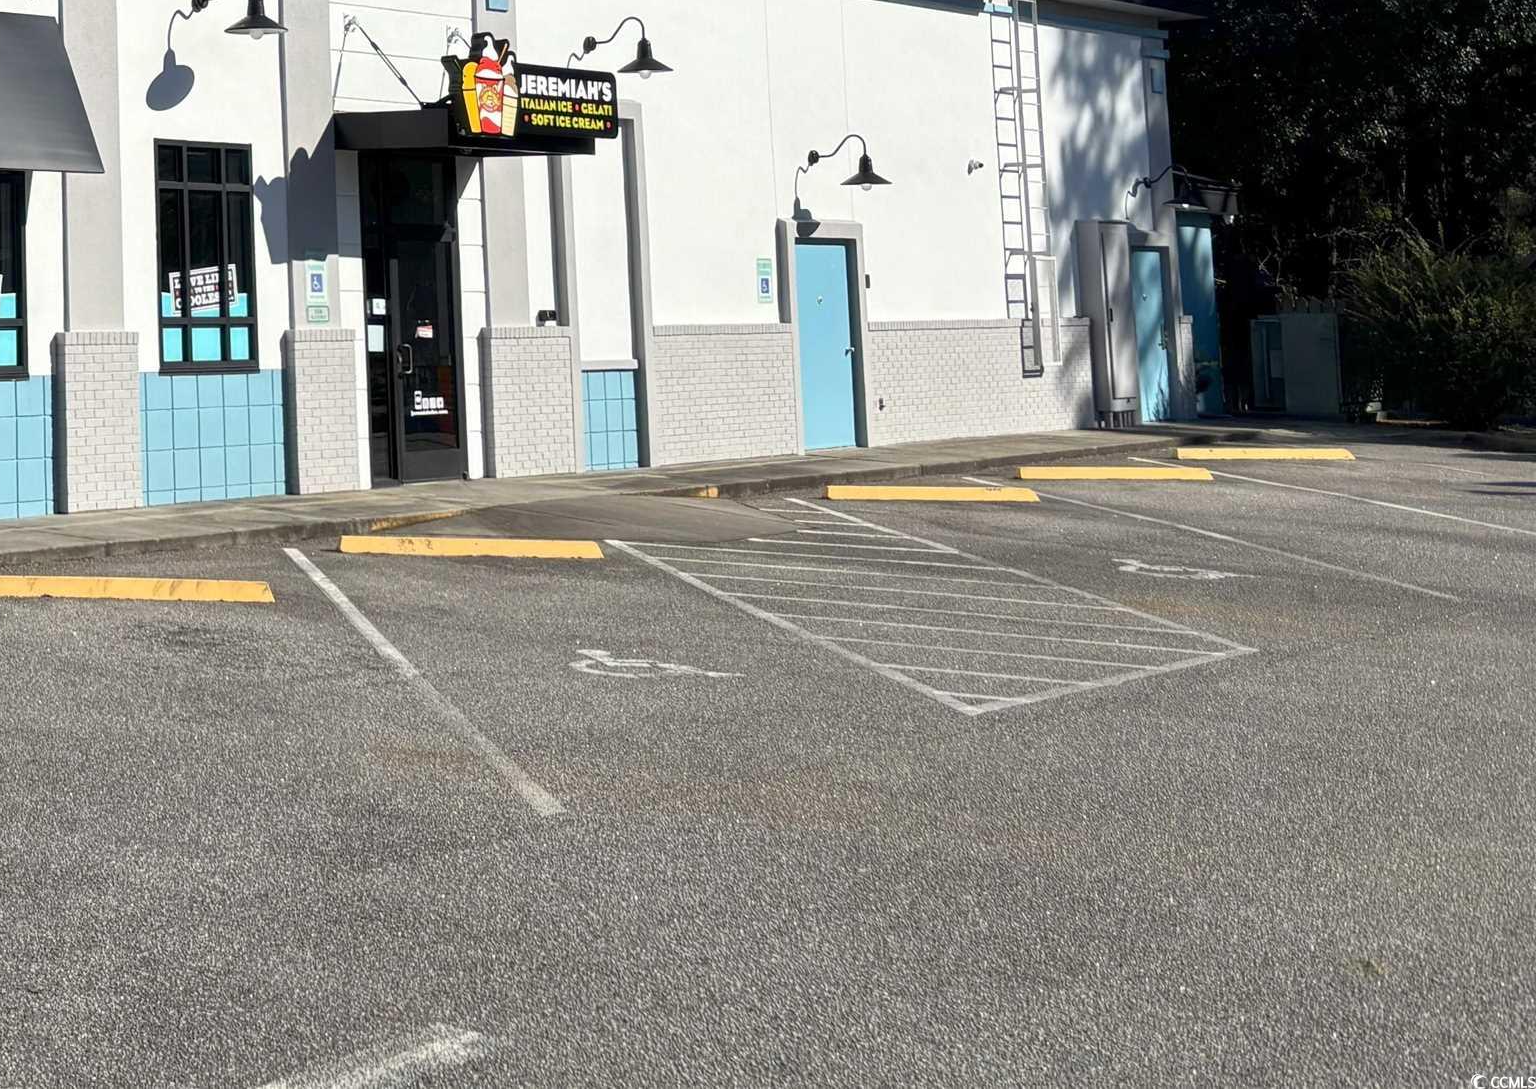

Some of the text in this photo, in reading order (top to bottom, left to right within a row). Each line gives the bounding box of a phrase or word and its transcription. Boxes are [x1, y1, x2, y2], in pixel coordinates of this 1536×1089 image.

[519, 74, 612, 102] JEREMIAH'S
[520, 98, 613, 116] ITALIAN ICE GELATI
[531, 114, 604, 131] SOFT ICE CREAM
